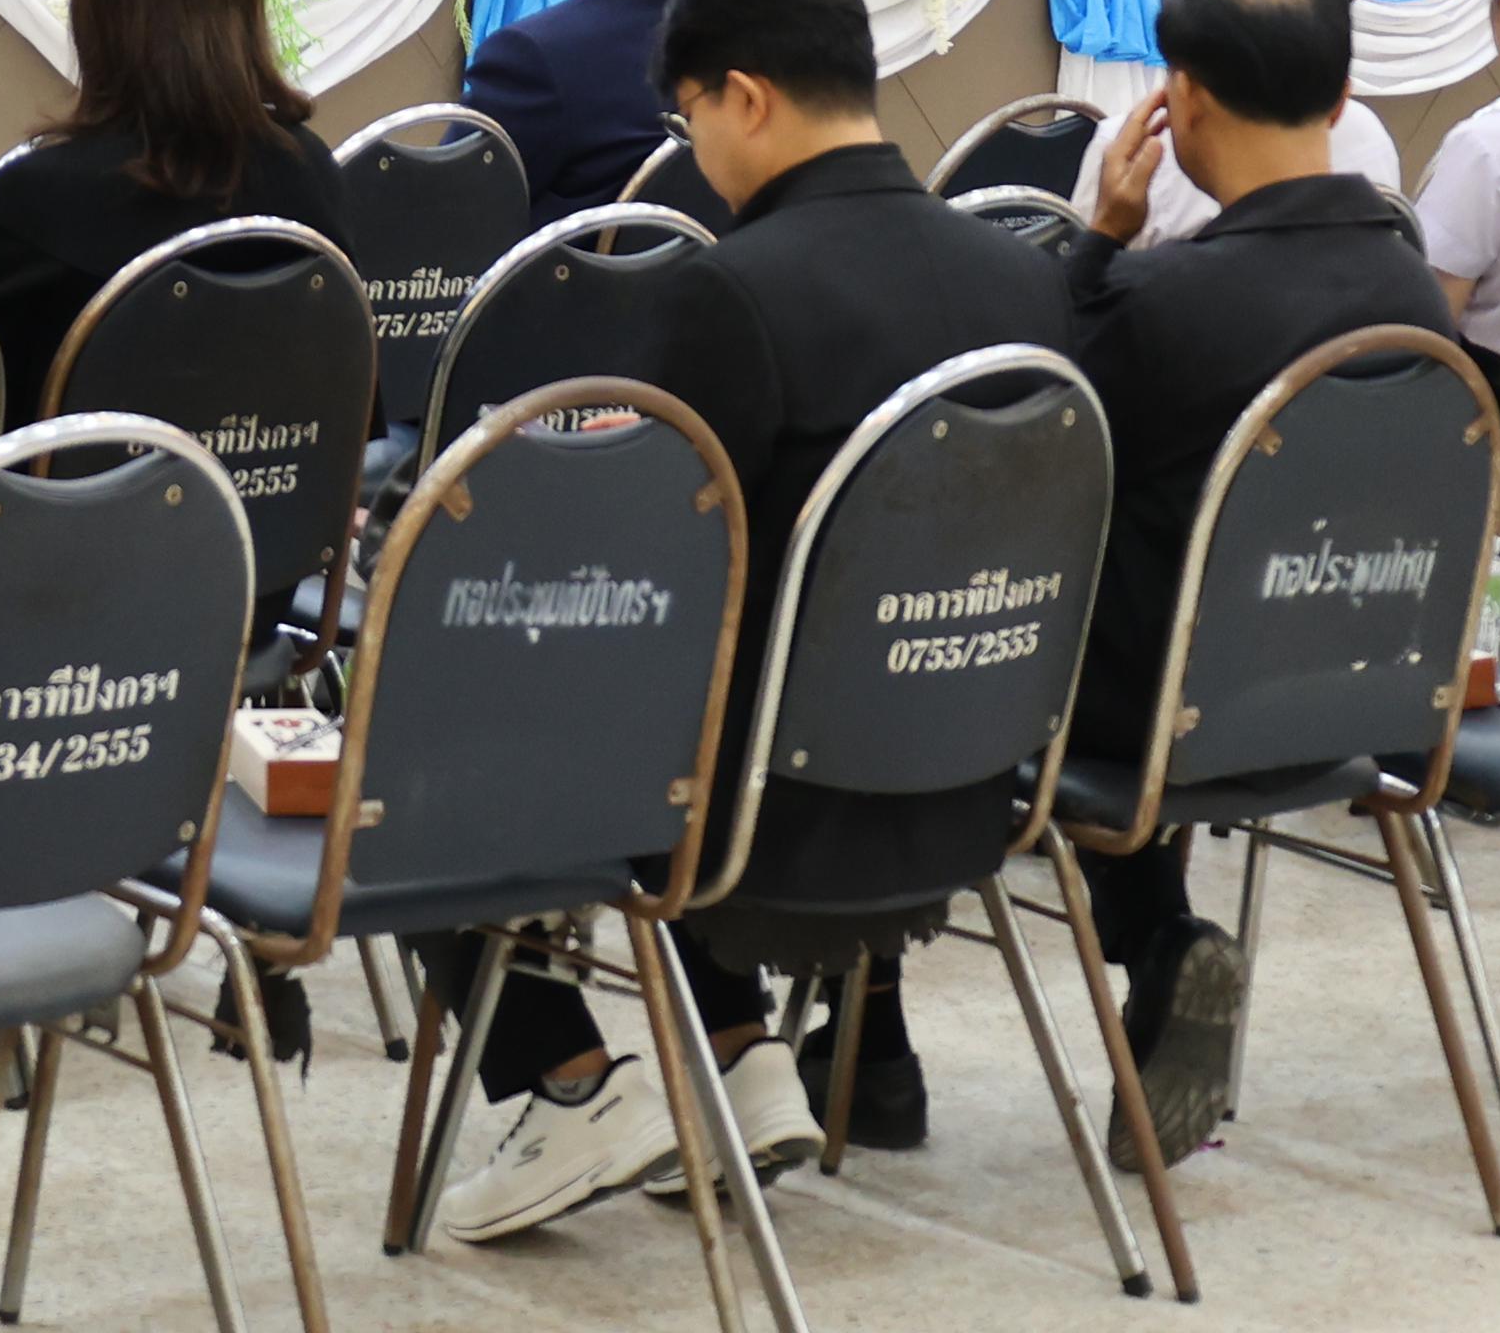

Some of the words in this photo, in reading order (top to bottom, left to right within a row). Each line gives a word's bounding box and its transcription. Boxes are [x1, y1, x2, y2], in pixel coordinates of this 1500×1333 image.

[876, 569, 1062, 626] อาคารทีปังกรฯ
[887, 621, 1041, 674] 0755/2555
